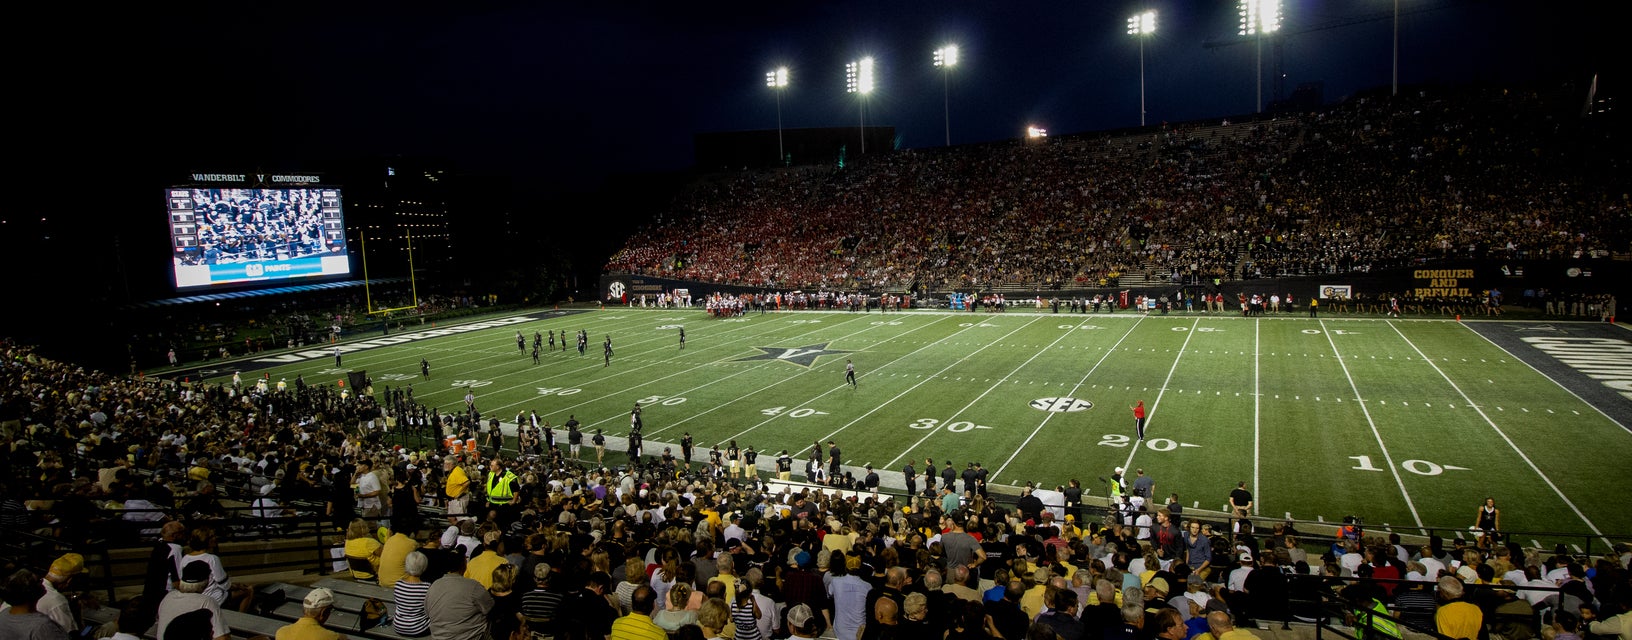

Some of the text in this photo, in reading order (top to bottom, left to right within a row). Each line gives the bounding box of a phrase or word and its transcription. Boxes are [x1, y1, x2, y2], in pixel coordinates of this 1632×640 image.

[192, 173, 246, 182] VANDERBILT
[257, 174, 264, 182] V
[272, 174, 320, 183] COMMODORES
[1414, 269, 1474, 279] CONQUER
[1430, 279, 1458, 288] AND
[609, 281, 626, 299] SEC
[1414, 288, 1473, 297] PREVAIL
[776, 348, 824, 360] V
[637, 395, 687, 406] 50
[1030, 397, 1093, 412] SEC
[760, 405, 815, 418] 40
[909, 418, 975, 432] 30
[1097, 433, 1178, 451] 20
[1348, 455, 1444, 476] 10
